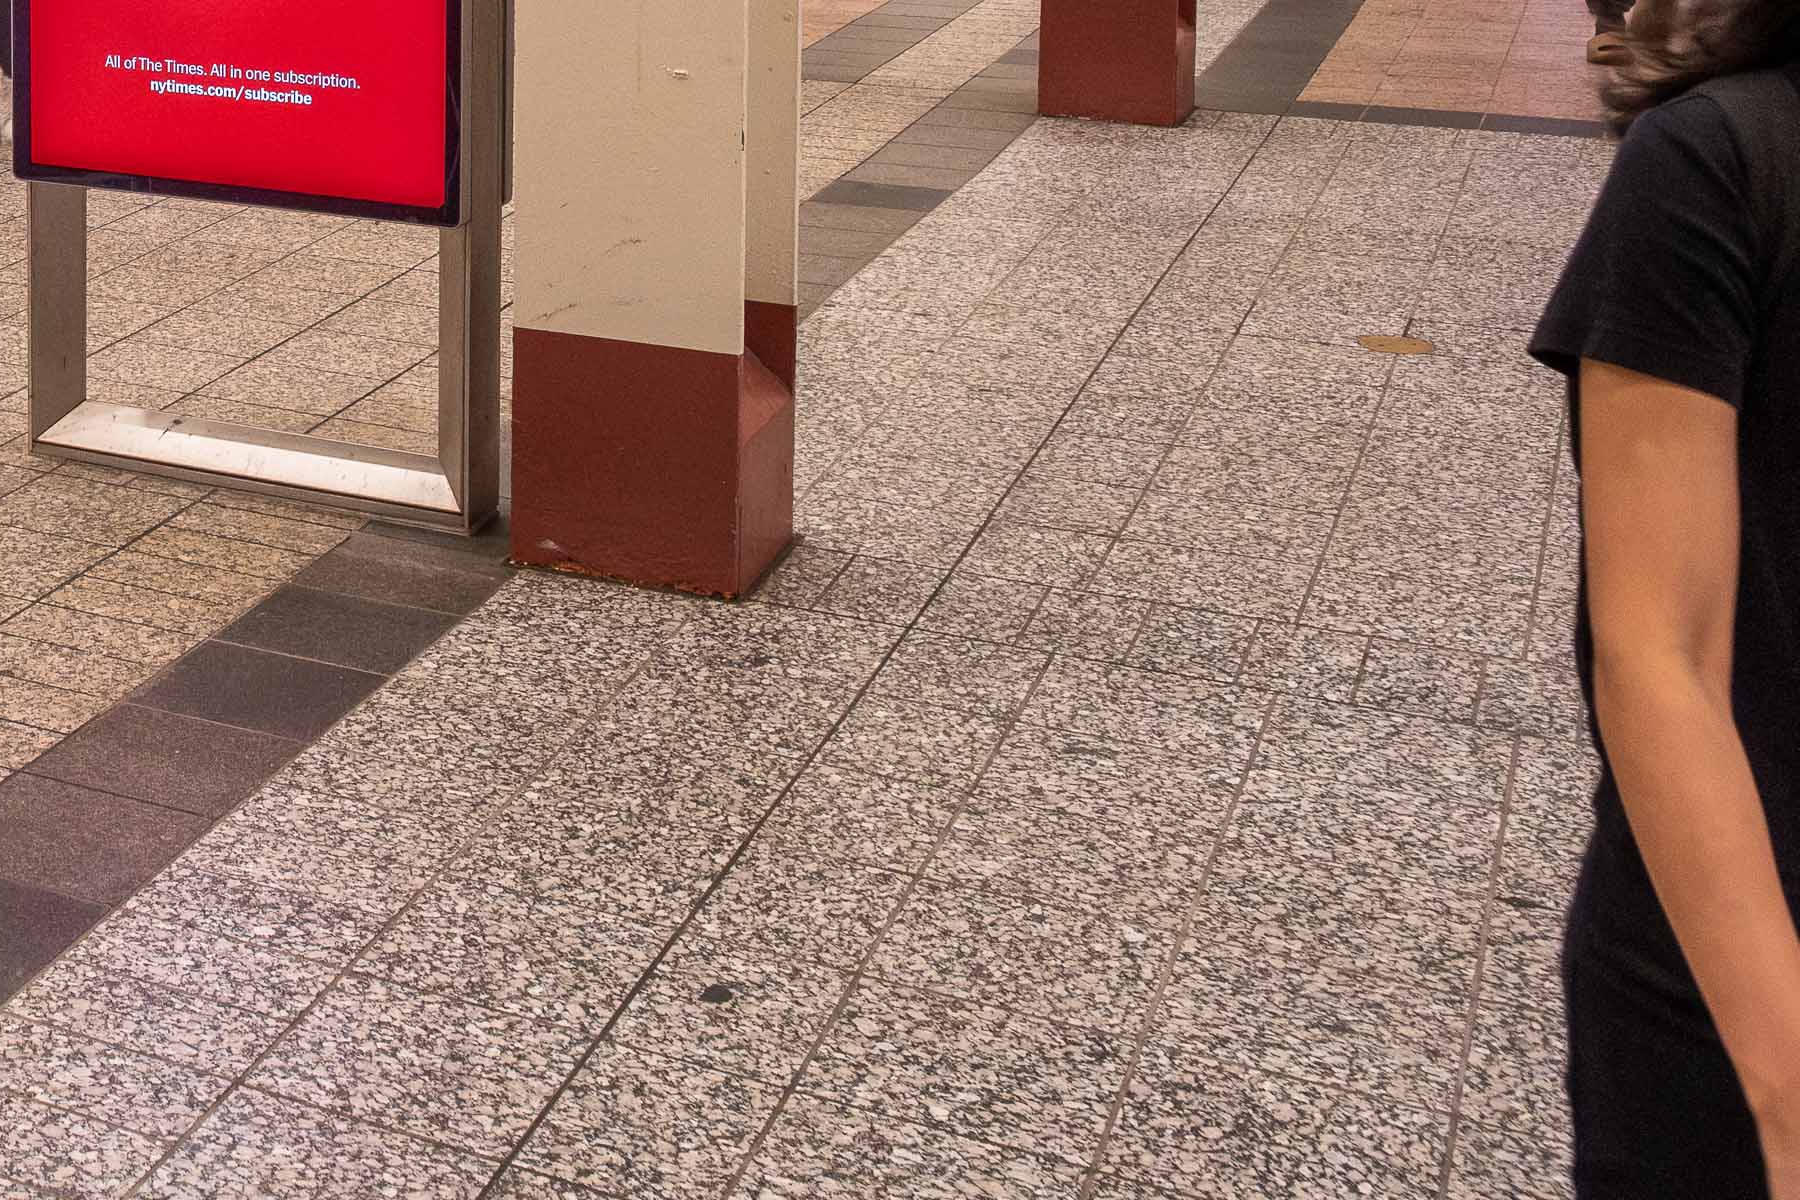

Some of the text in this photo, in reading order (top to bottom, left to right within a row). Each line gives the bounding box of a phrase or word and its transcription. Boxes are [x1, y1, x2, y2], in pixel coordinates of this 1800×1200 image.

[104, 54, 361, 90] All of The Times. All in one subscription.
[150, 78, 313, 106] nytimes.com/subscribe
